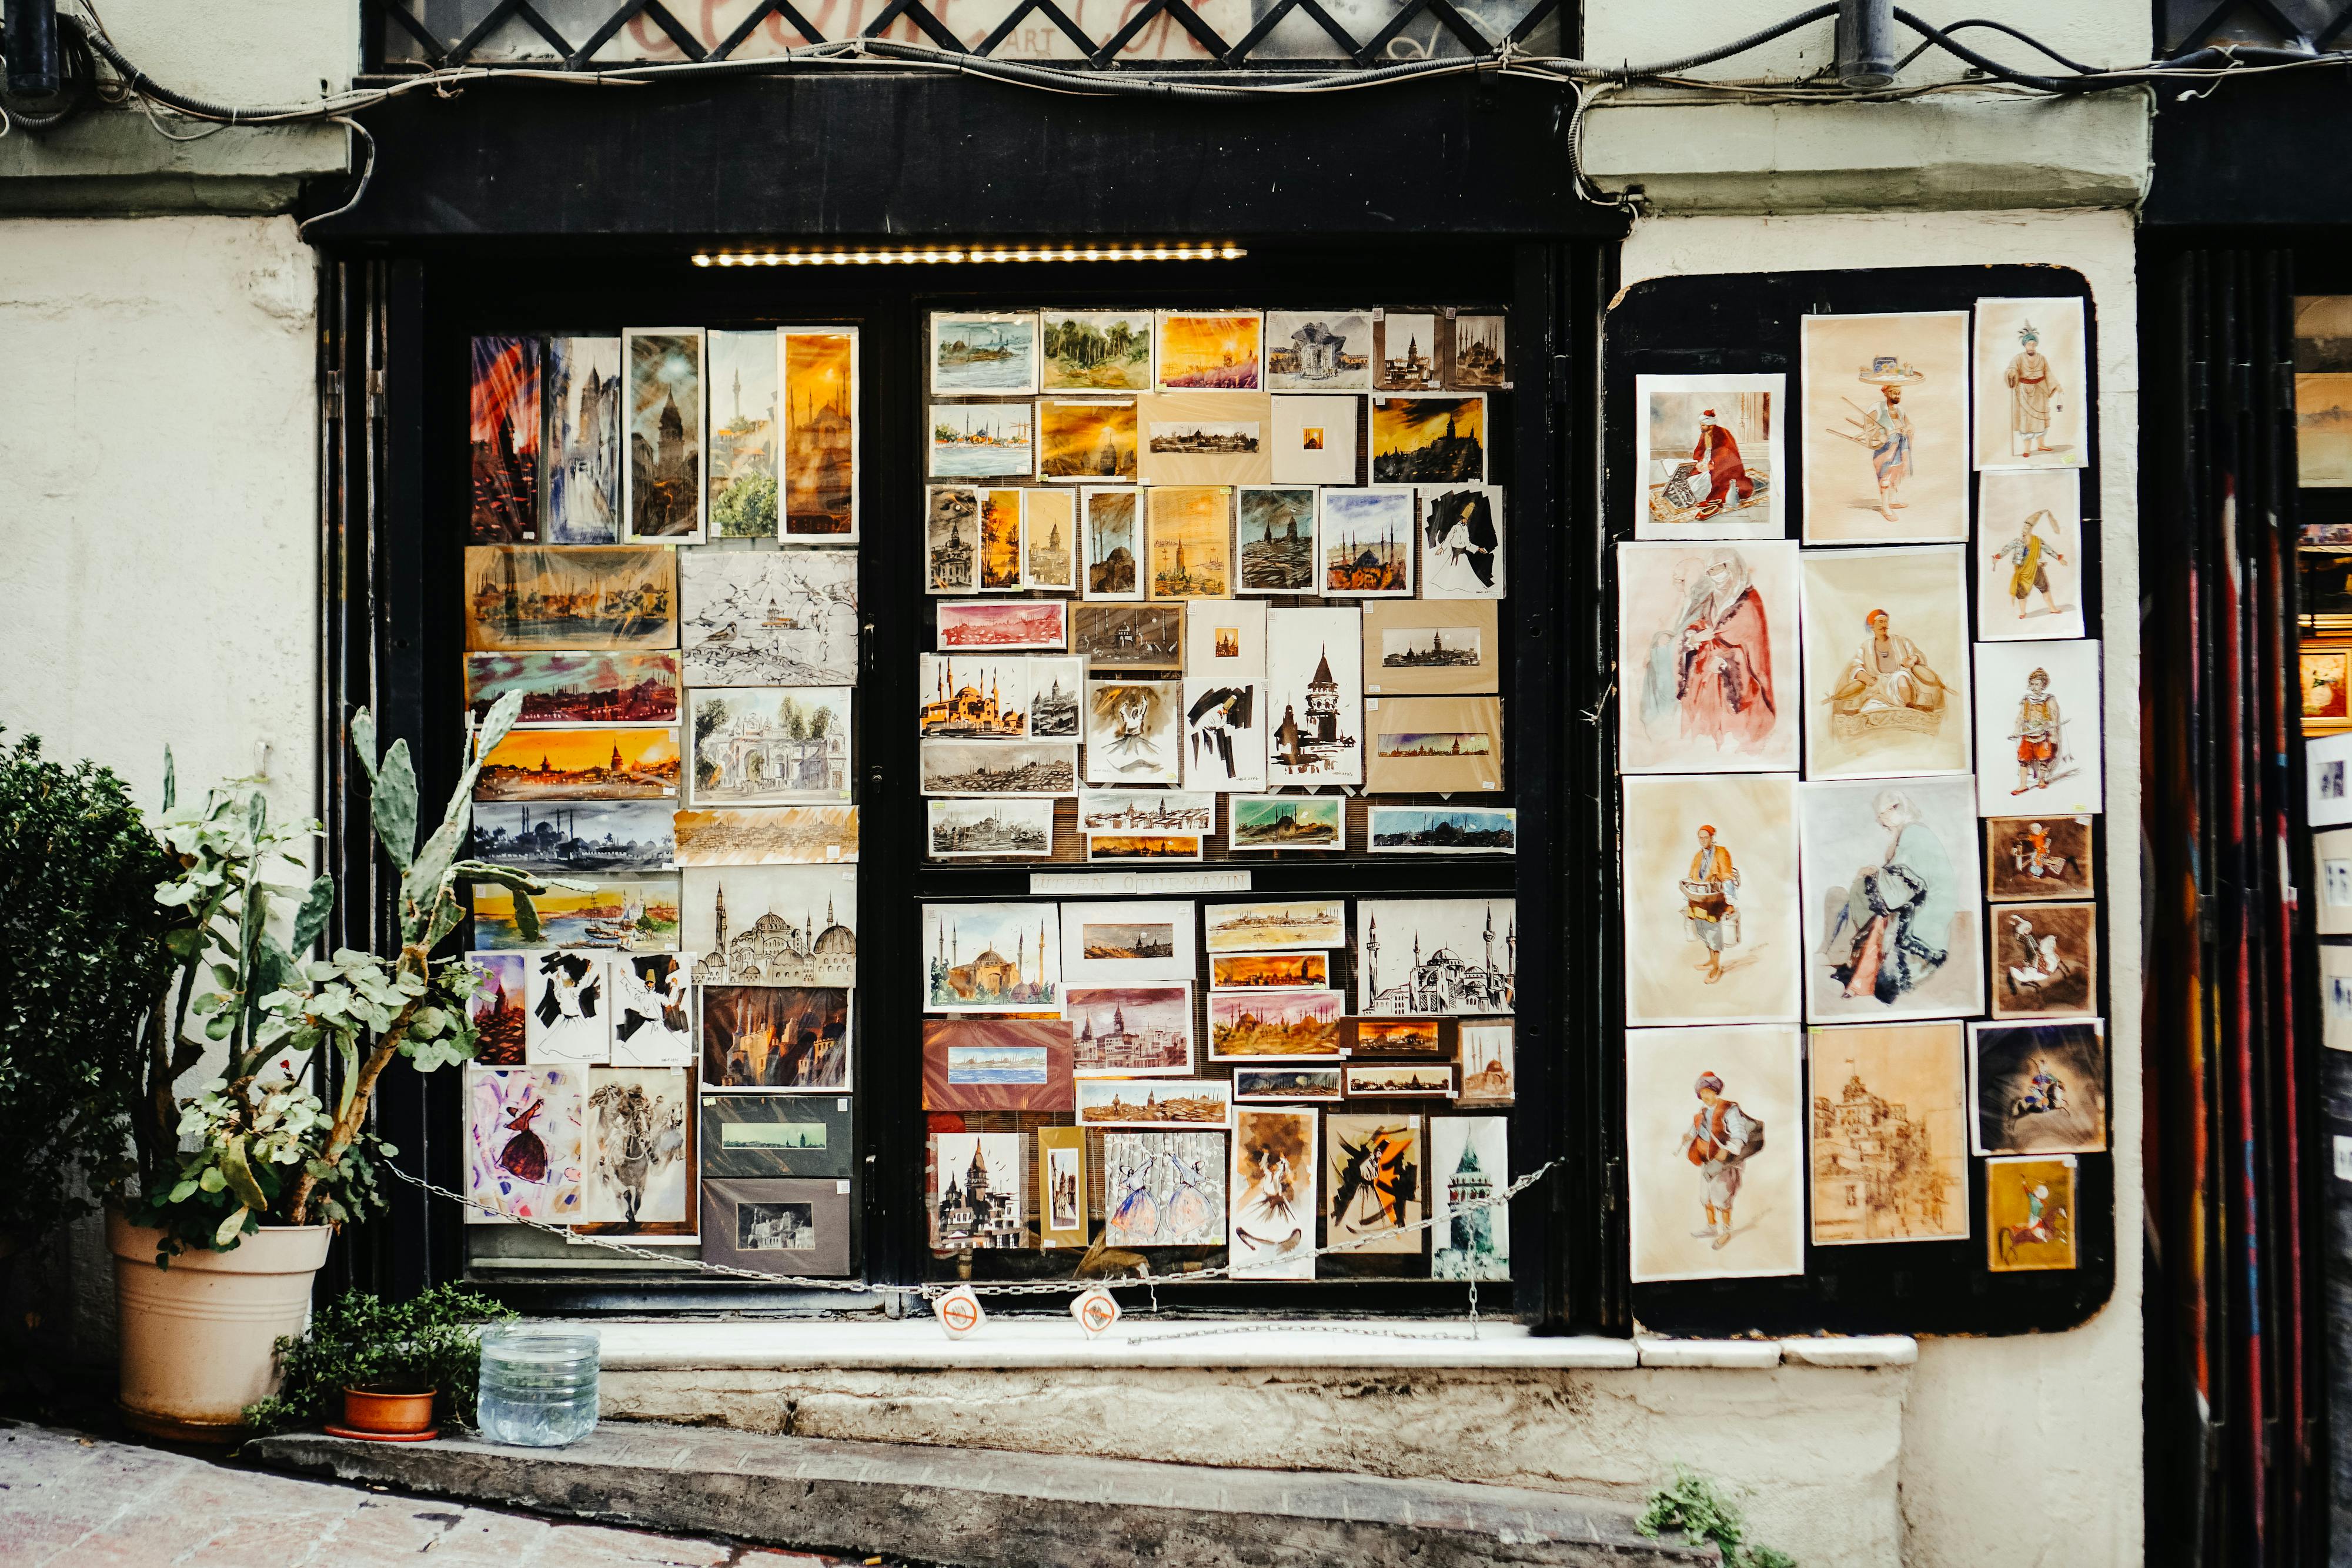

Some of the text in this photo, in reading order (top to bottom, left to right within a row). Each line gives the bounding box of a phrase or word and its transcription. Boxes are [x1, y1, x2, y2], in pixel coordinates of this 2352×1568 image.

[998, 28, 1055, 52] ART
[1033, 874, 1245, 890] LÜTFEN OTURMAYIN
